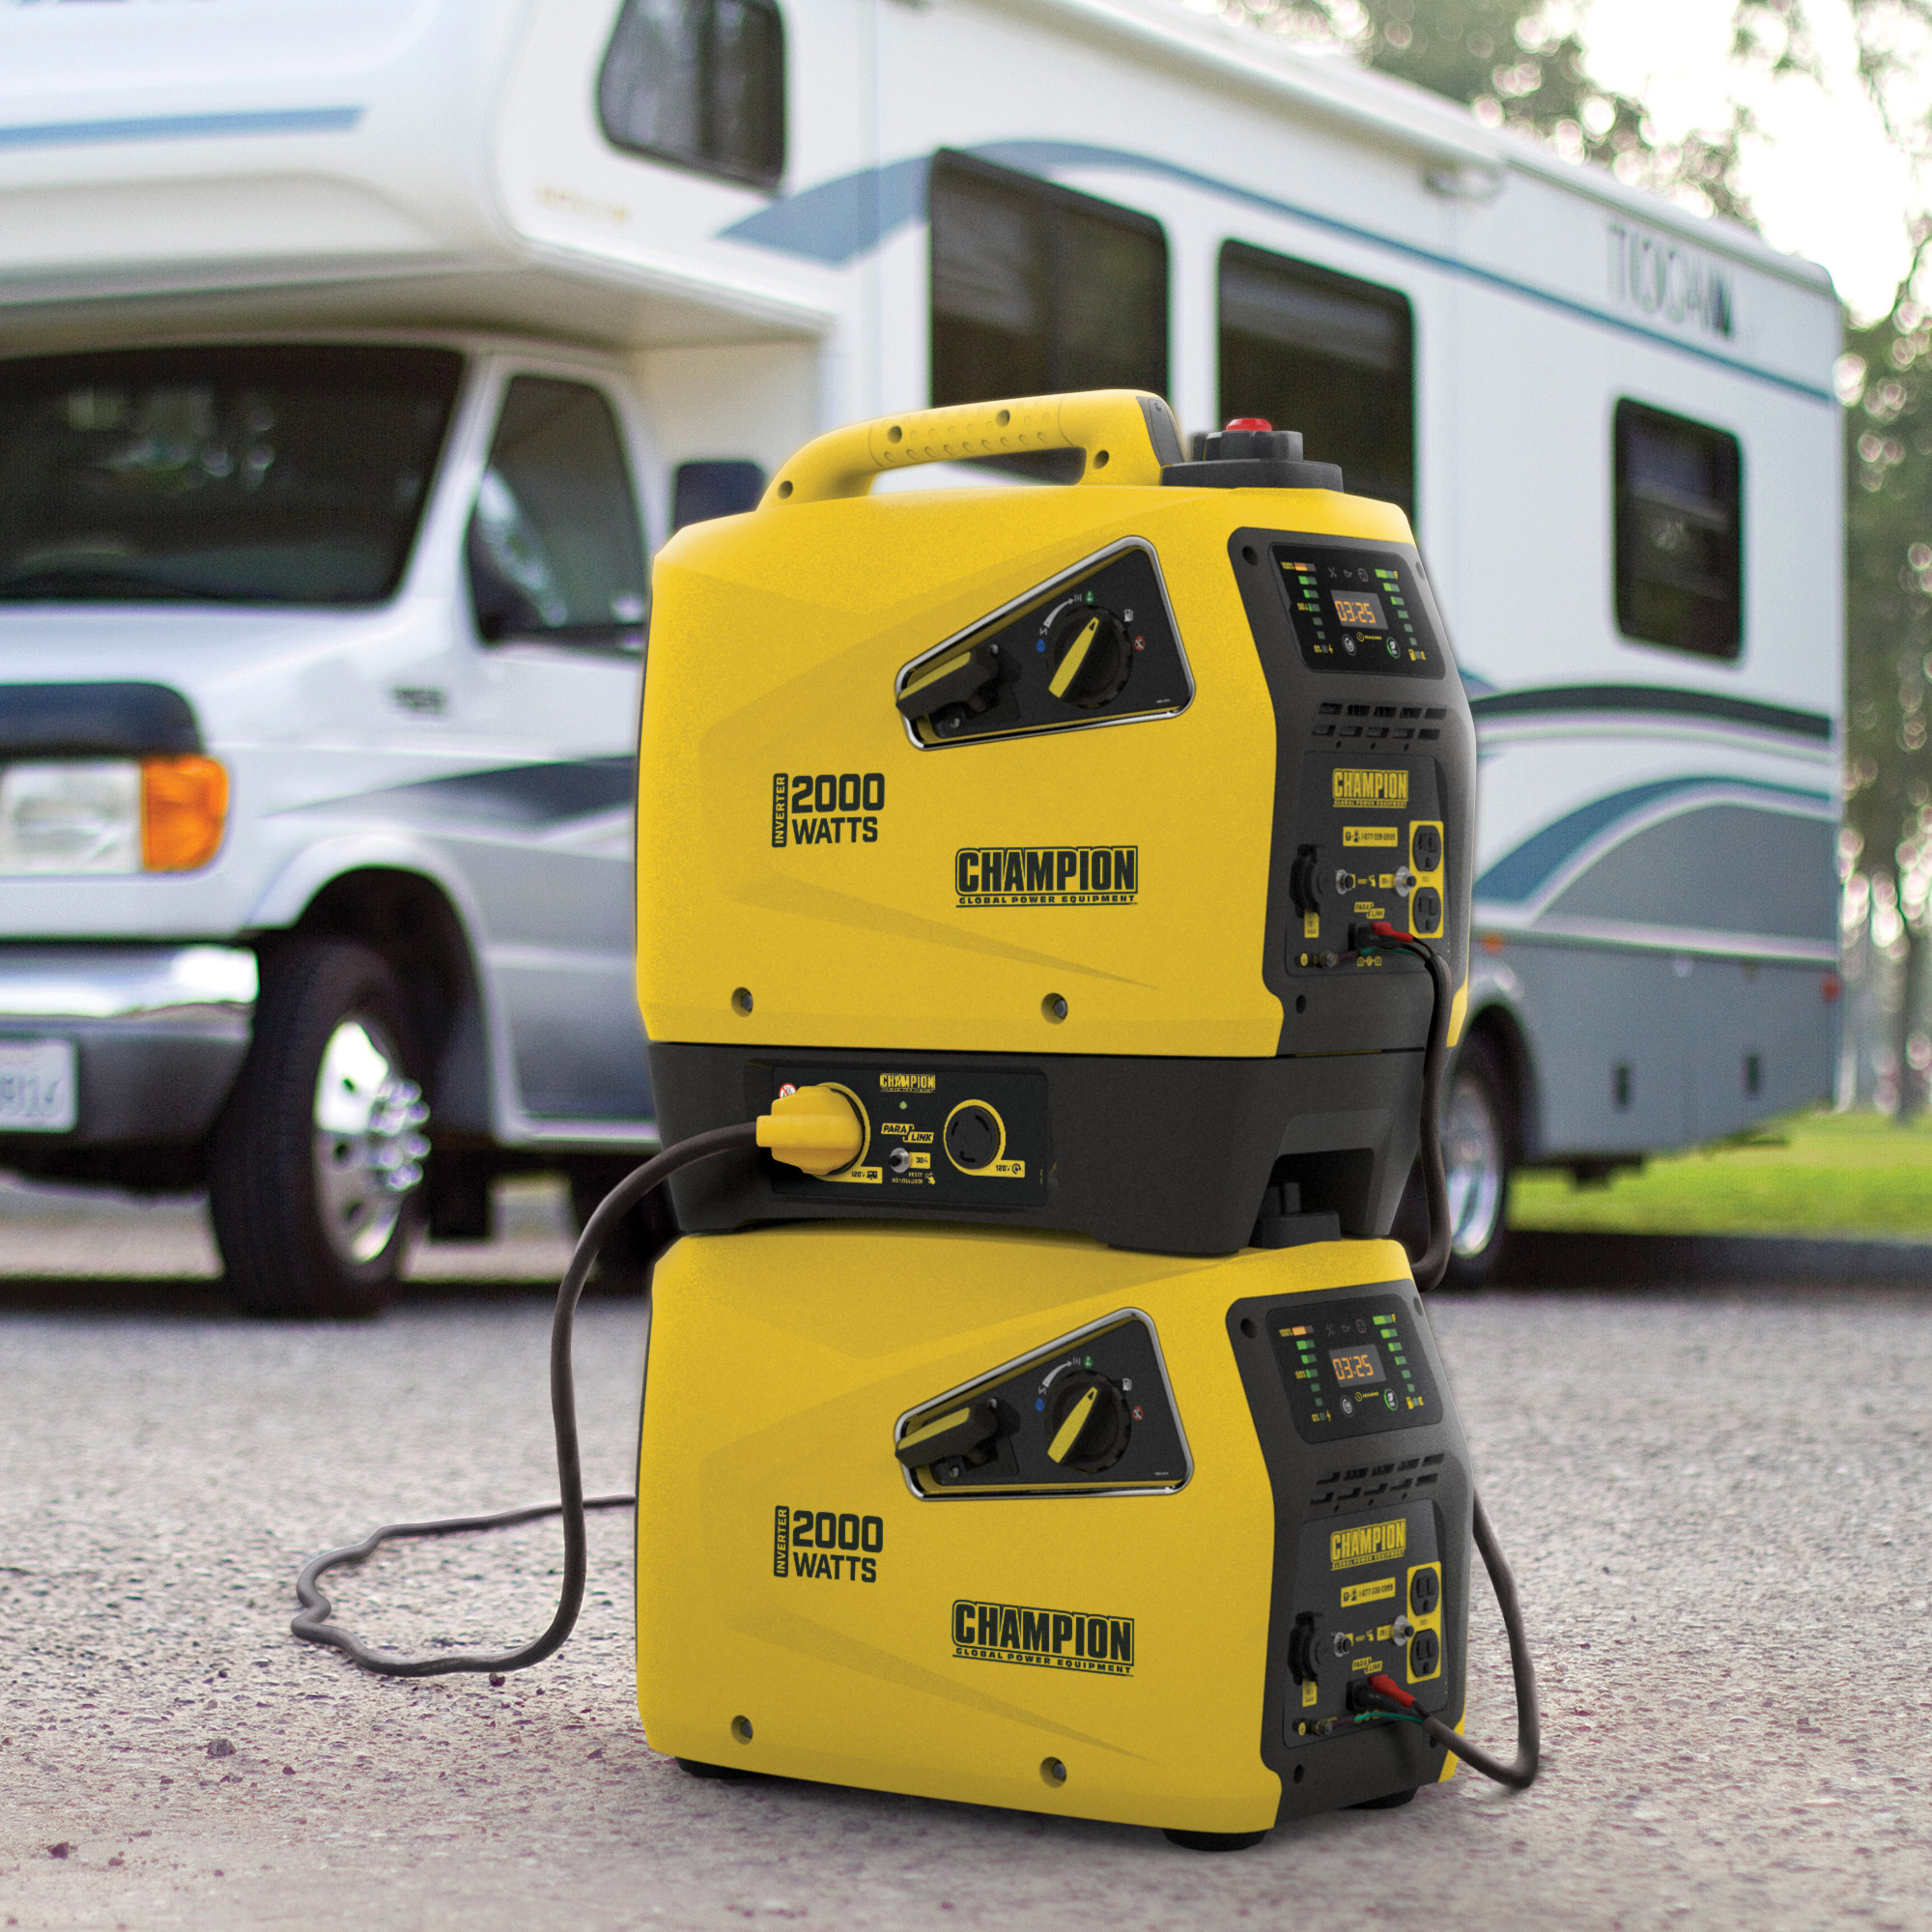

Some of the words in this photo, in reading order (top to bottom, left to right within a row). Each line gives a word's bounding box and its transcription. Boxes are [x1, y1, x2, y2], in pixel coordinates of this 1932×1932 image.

[791, 773, 885, 814] 2000
[1334, 771, 1407, 799] CHAMPION
[774, 776, 786, 844] INVERTER
[791, 816, 878, 845] WATTS
[958, 849, 1135, 893] CHAMPION
[959, 896, 1007, 905] GLOBAL
[1011, 895, 1056, 904] POWER
[1062, 895, 1135, 903] EQUIPMENT
[880, 1074, 935, 1089] CHAMPION
[883, 1124, 907, 1134] PARA
[911, 1133, 932, 1142] LINK
[776, 1508, 787, 1575] INVERTER
[792, 1510, 884, 1553] 2000
[1333, 1520, 1406, 1561] CHAMPION
[792, 1551, 877, 1583] WATTS
[954, 1603, 1131, 1662] CHAMPION
[955, 1647, 1003, 1660] GLOBAL
[1008, 1653, 1051, 1664] POWER
[1058, 1659, 1130, 1674] EQUIPMENT
